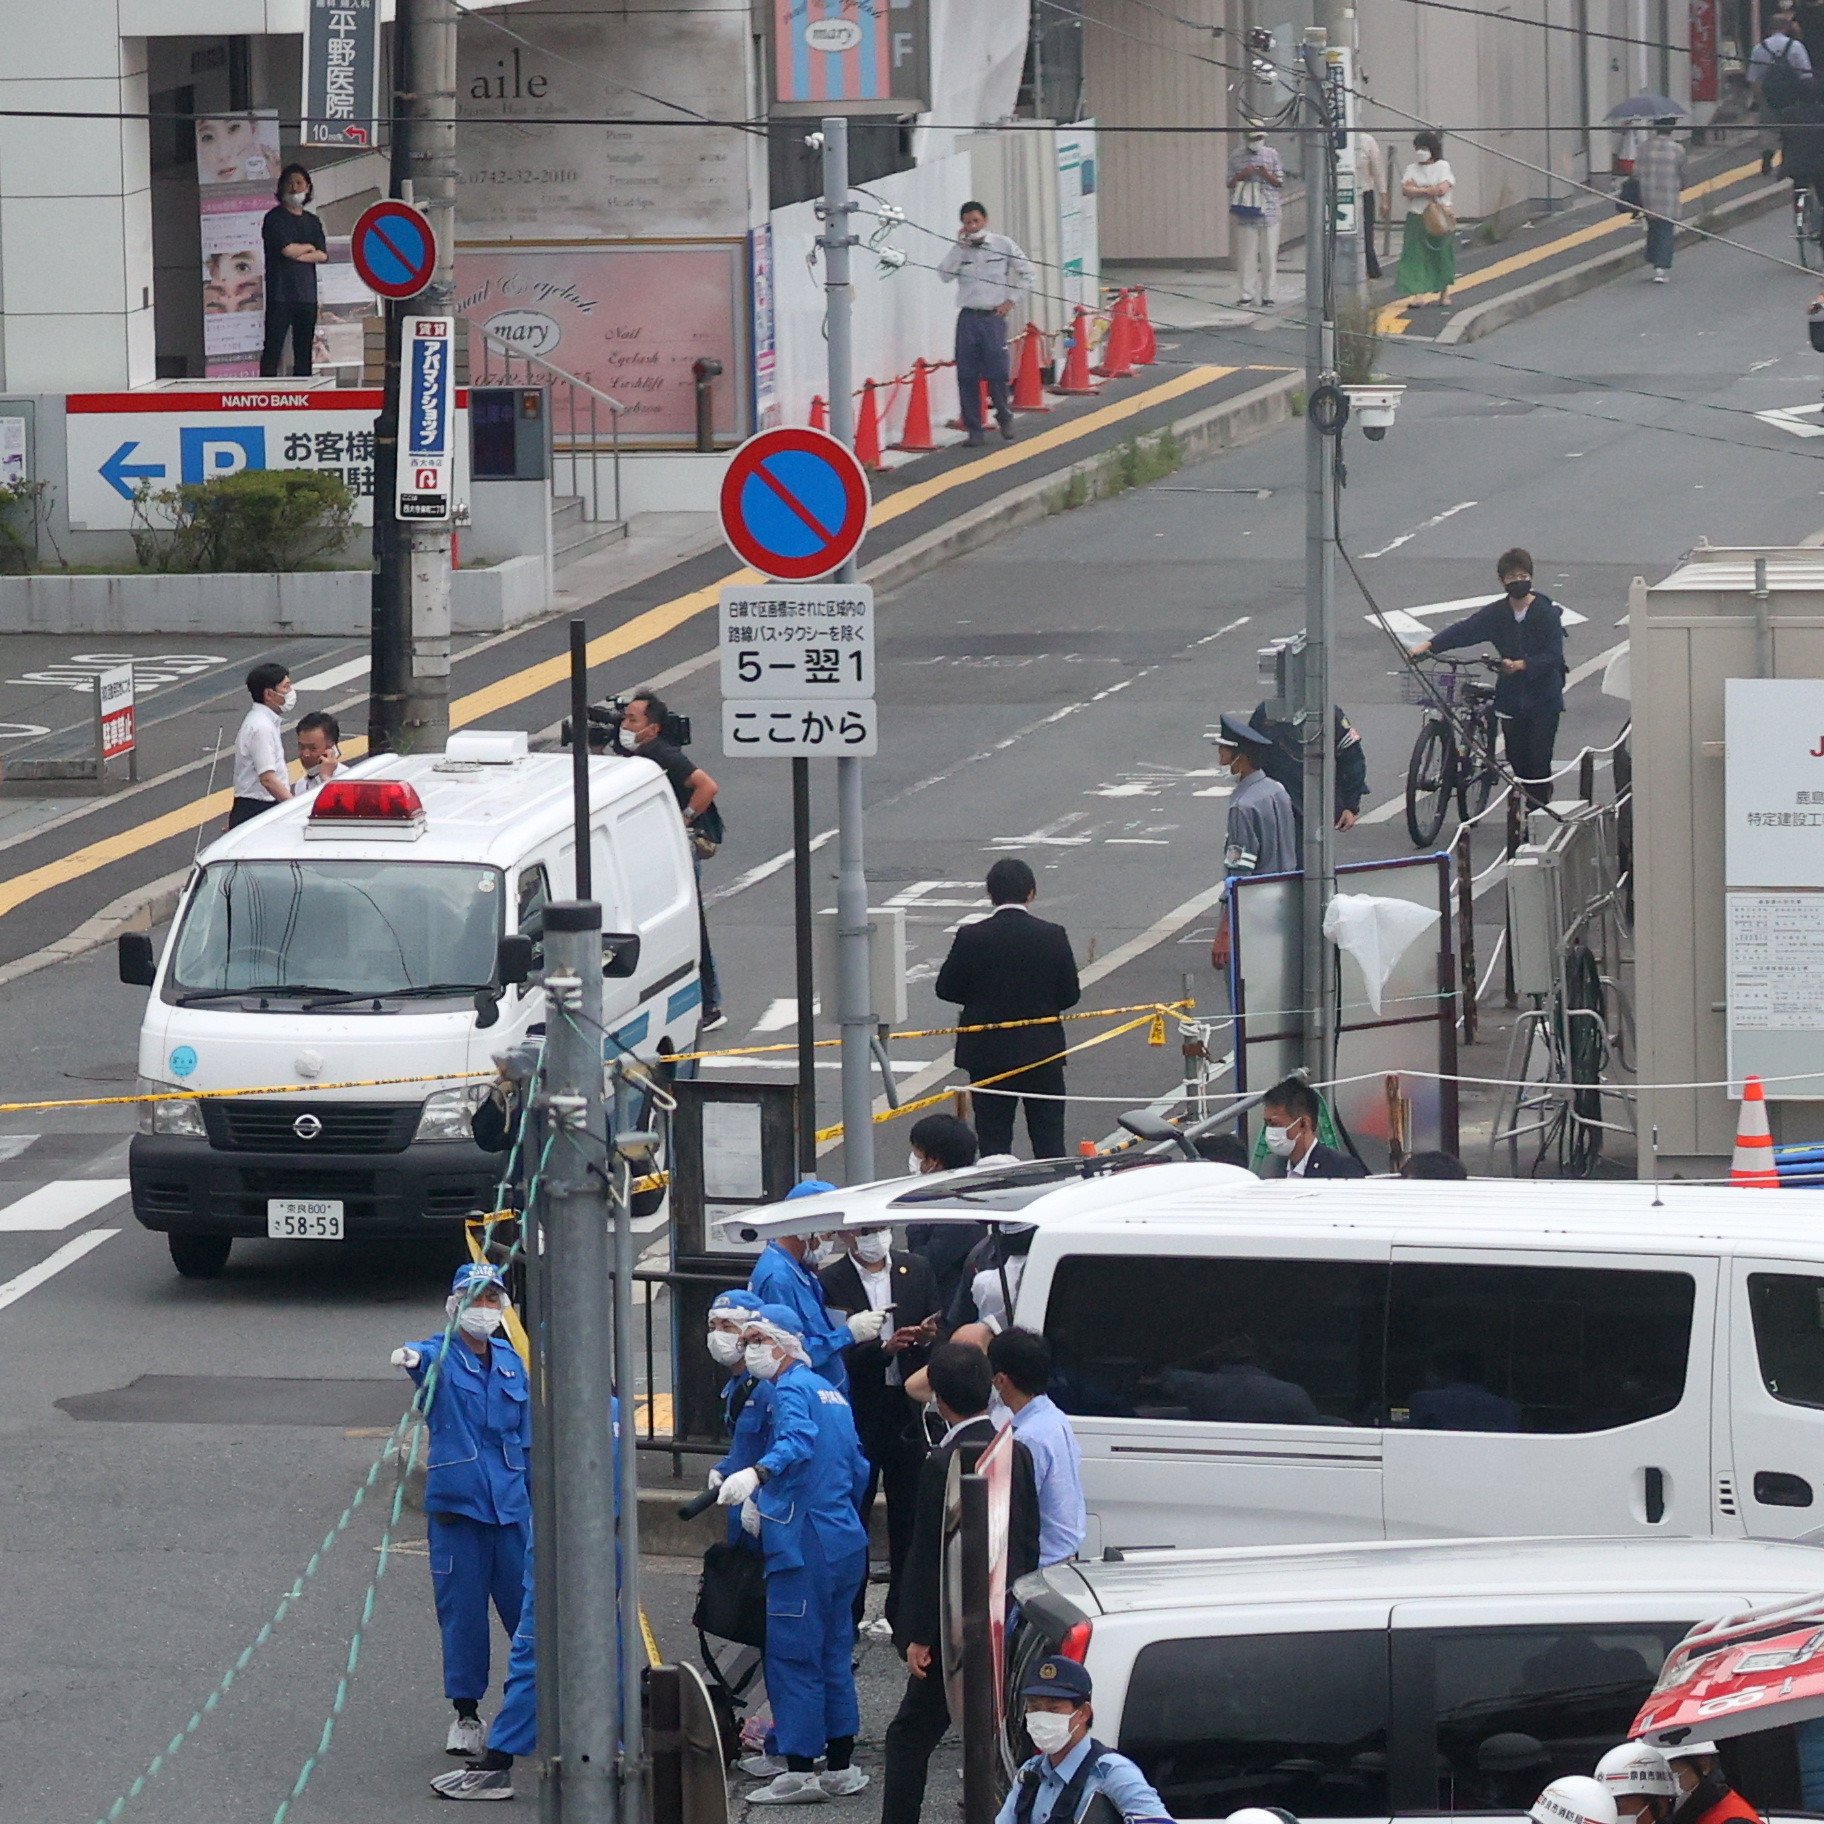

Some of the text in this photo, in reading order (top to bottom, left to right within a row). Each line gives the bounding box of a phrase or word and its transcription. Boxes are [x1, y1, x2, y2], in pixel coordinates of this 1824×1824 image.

[813, 28, 853, 44] mary
[326, 10, 356, 119] 平野医院
[470, 47, 548, 98] aile
[419, 323, 446, 336] 賃貸
[494, 322, 549, 348] mary
[605, 327, 641, 340] Nail
[221, 394, 309, 407] NANTO BANK
[420, 341, 441, 446] アパマンショップ
[284, 431, 375, 462] お客様
[410, 458, 442, 467] 西大寺店
[729, 601, 866, 617] 白線で区画標示された区域内の
[729, 625, 865, 643] 路線バス・タクシーを除く
[103, 712, 133, 751] 駐車禁止
[733, 711, 867, 744] ここから
[285, 1216, 339, 1236] 58-59
